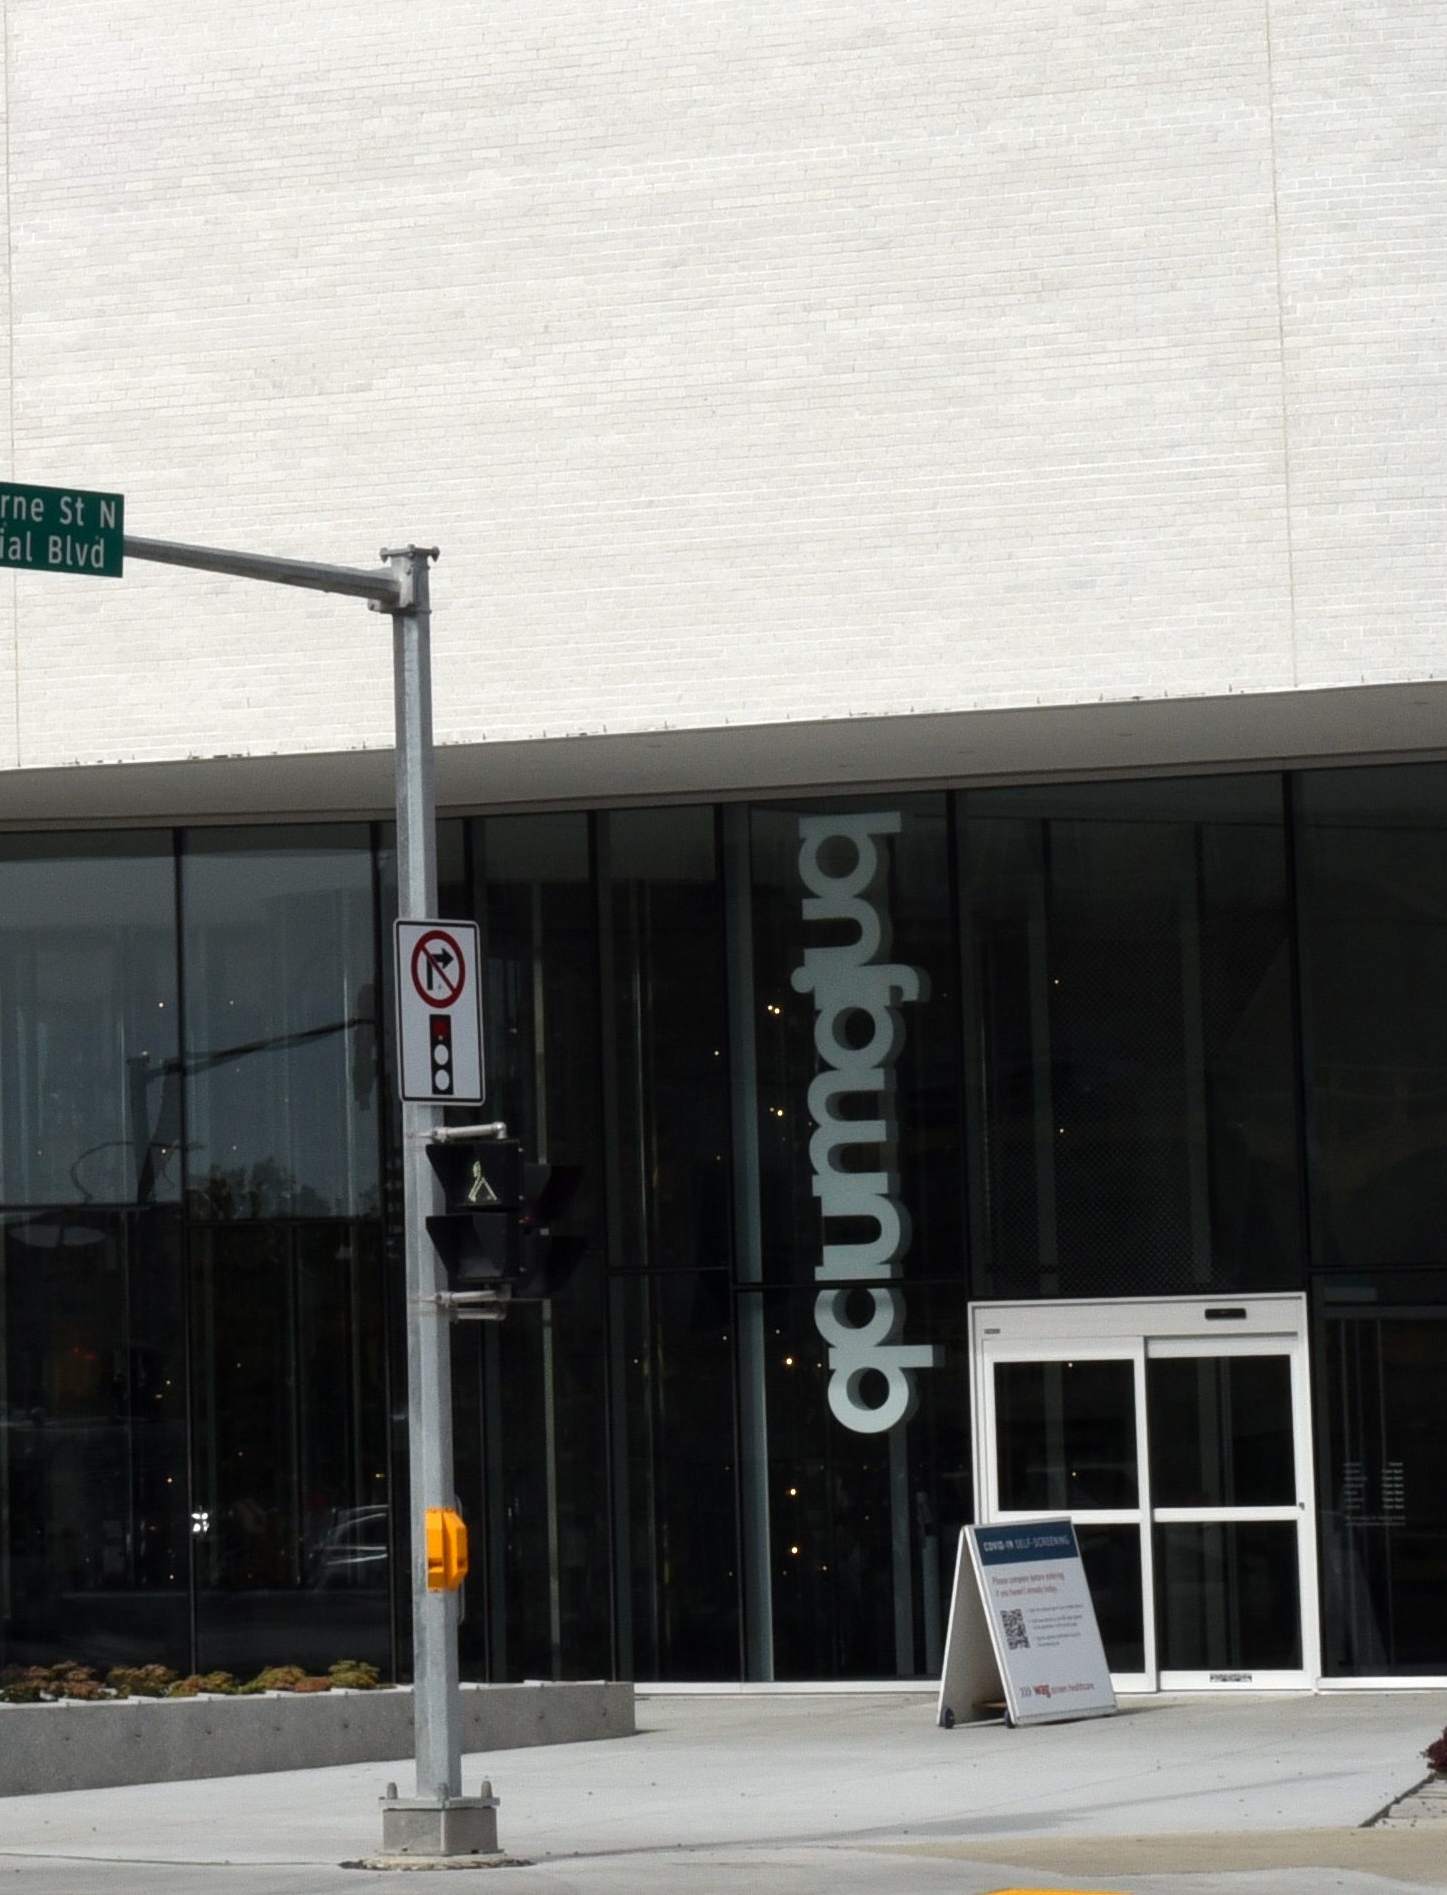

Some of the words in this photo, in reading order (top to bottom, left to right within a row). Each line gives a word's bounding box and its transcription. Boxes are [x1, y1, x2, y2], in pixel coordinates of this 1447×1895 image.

[59, 496, 84, 526] St
[100, 500, 115, 529] N
[48, 535, 104, 569] Blvd
[790, 811, 934, 1433] qaumajuq
